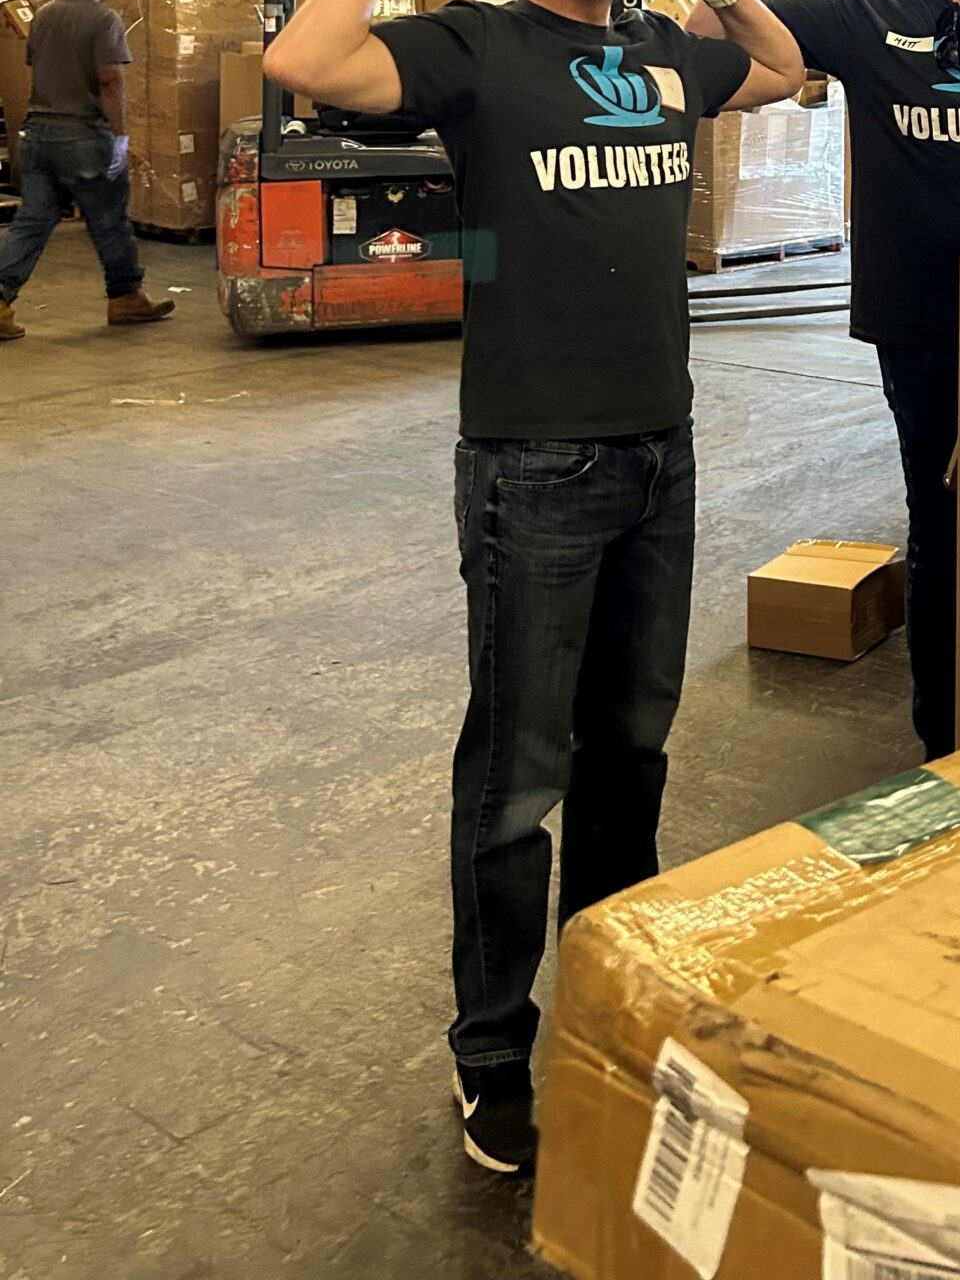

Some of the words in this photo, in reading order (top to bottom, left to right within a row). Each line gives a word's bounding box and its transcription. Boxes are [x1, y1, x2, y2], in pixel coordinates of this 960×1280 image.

[309, 159, 359, 170] TOYOTA
[530, 141, 691, 192] VOLUNTEER
[368, 242, 423, 256] POWERLINE
